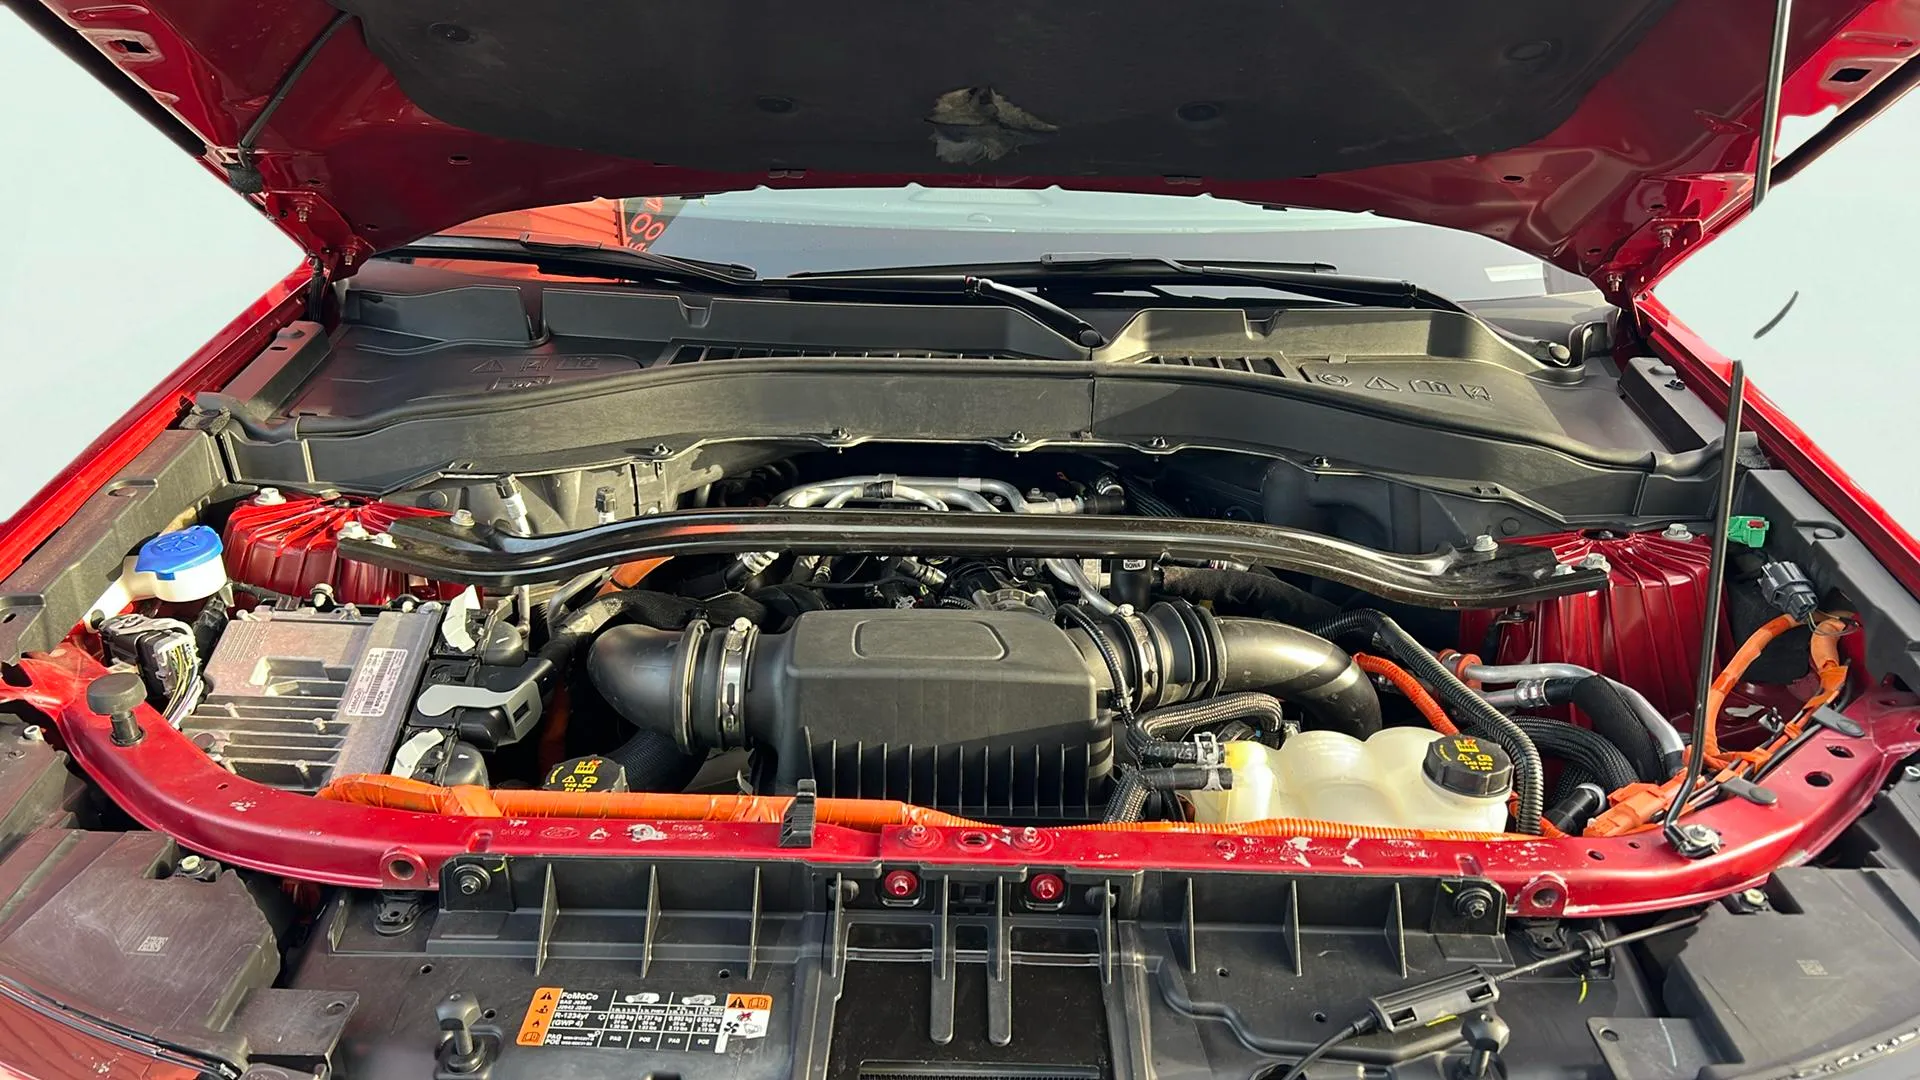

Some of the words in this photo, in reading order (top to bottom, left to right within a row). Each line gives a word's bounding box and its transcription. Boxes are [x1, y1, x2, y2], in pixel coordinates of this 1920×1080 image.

[561, 992, 599, 1000] FoMoCo
[554, 1012, 590, 1020] R-1234yf
[575, 1020, 584, 1028] 4)
